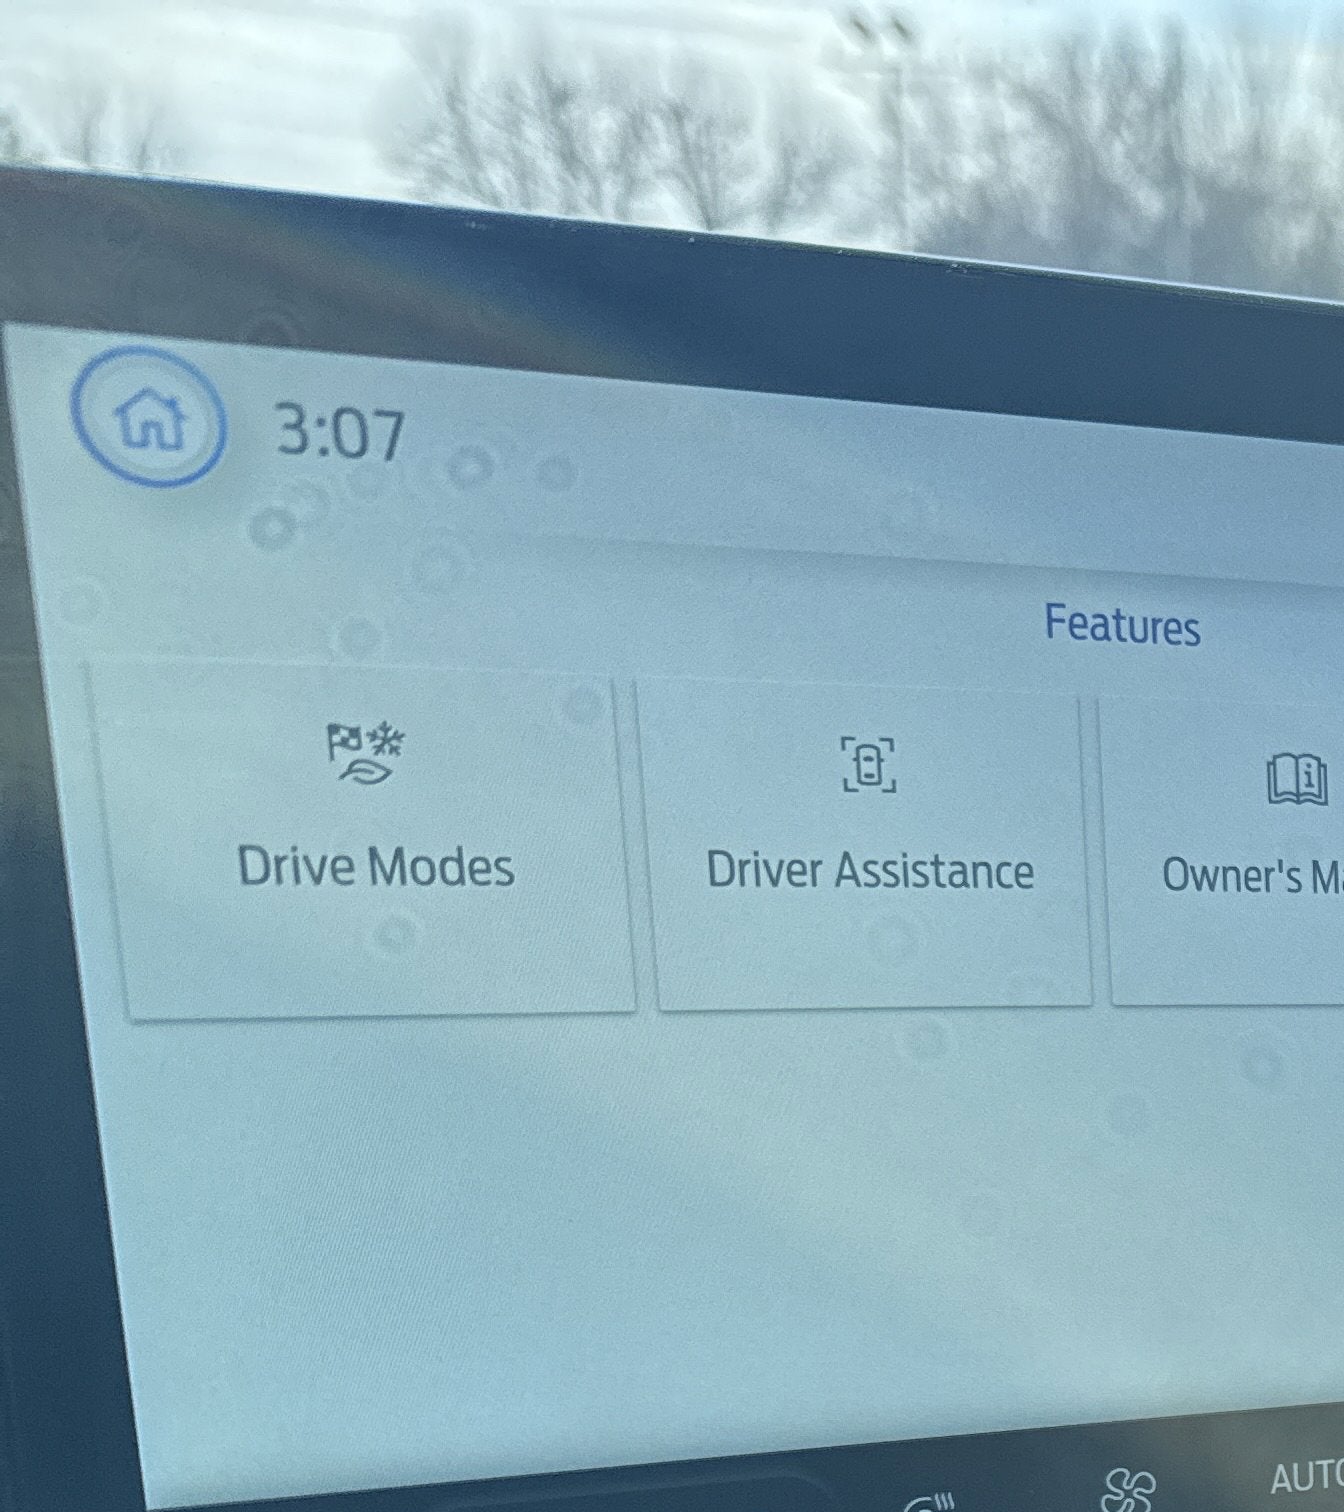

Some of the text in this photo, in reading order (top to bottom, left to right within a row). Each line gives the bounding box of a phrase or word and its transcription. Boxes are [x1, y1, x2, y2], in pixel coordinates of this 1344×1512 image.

[274, 401, 406, 462] 3:07
[1045, 603, 1201, 646] Features
[238, 845, 516, 887] Drive Modes
[707, 850, 1035, 890] Driver Assistance
[1162, 856, 1304, 895] Owner's
